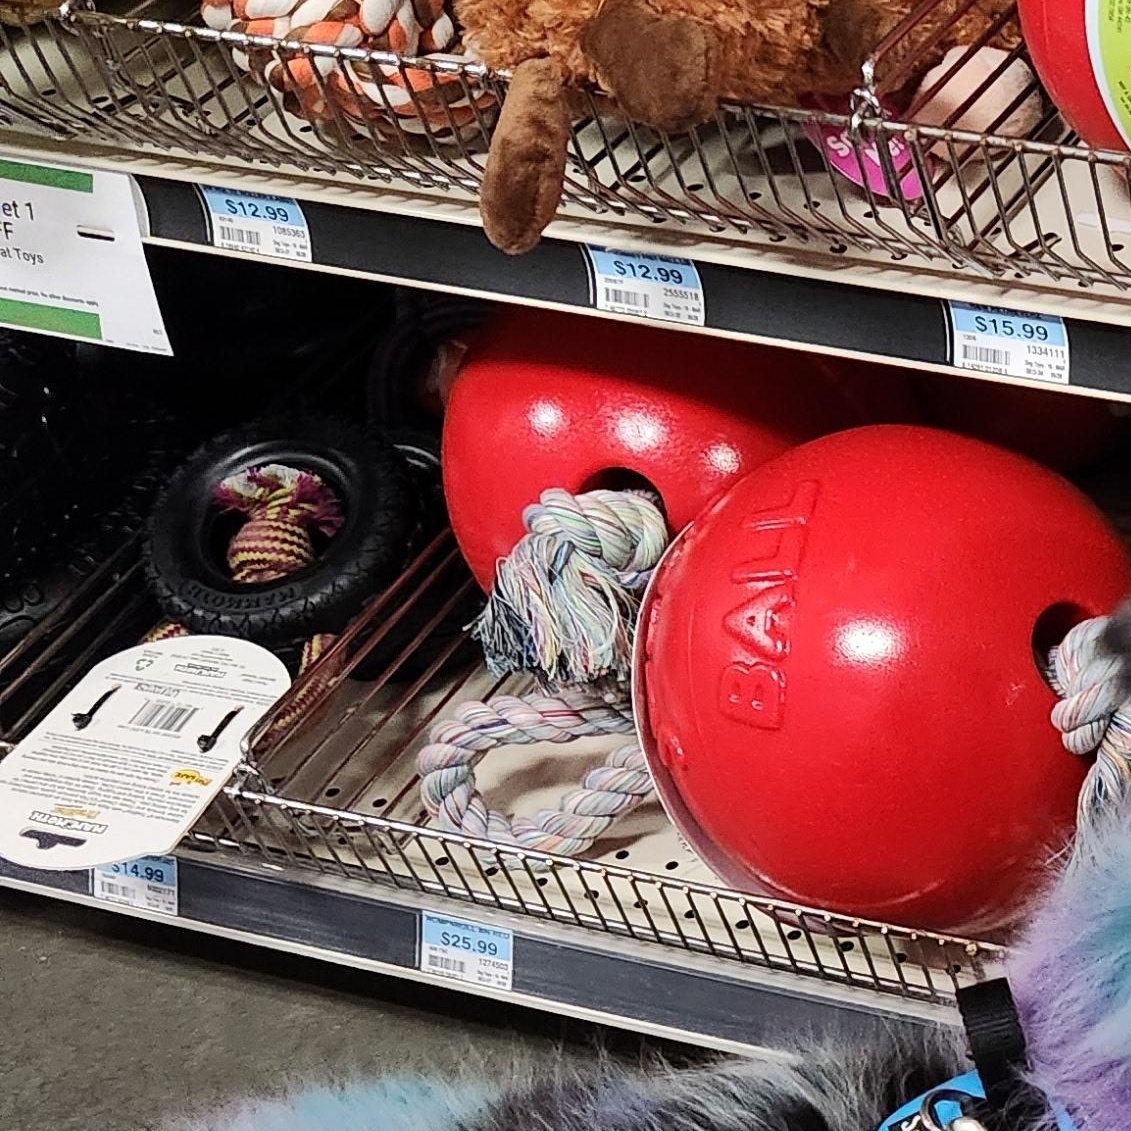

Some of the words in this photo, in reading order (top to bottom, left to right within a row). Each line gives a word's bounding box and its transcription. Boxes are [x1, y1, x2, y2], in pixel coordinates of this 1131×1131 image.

[0, 200, 20, 219] et
[25, 202, 34, 221] 1
[225, 199, 289, 222] $12.99
[13, 247, 44, 265] Toys
[613, 260, 683, 284] $12.99
[975, 316, 1048, 341] $15.99
[718, 479, 821, 731] BALL
[440, 931, 498, 956] $25.99
